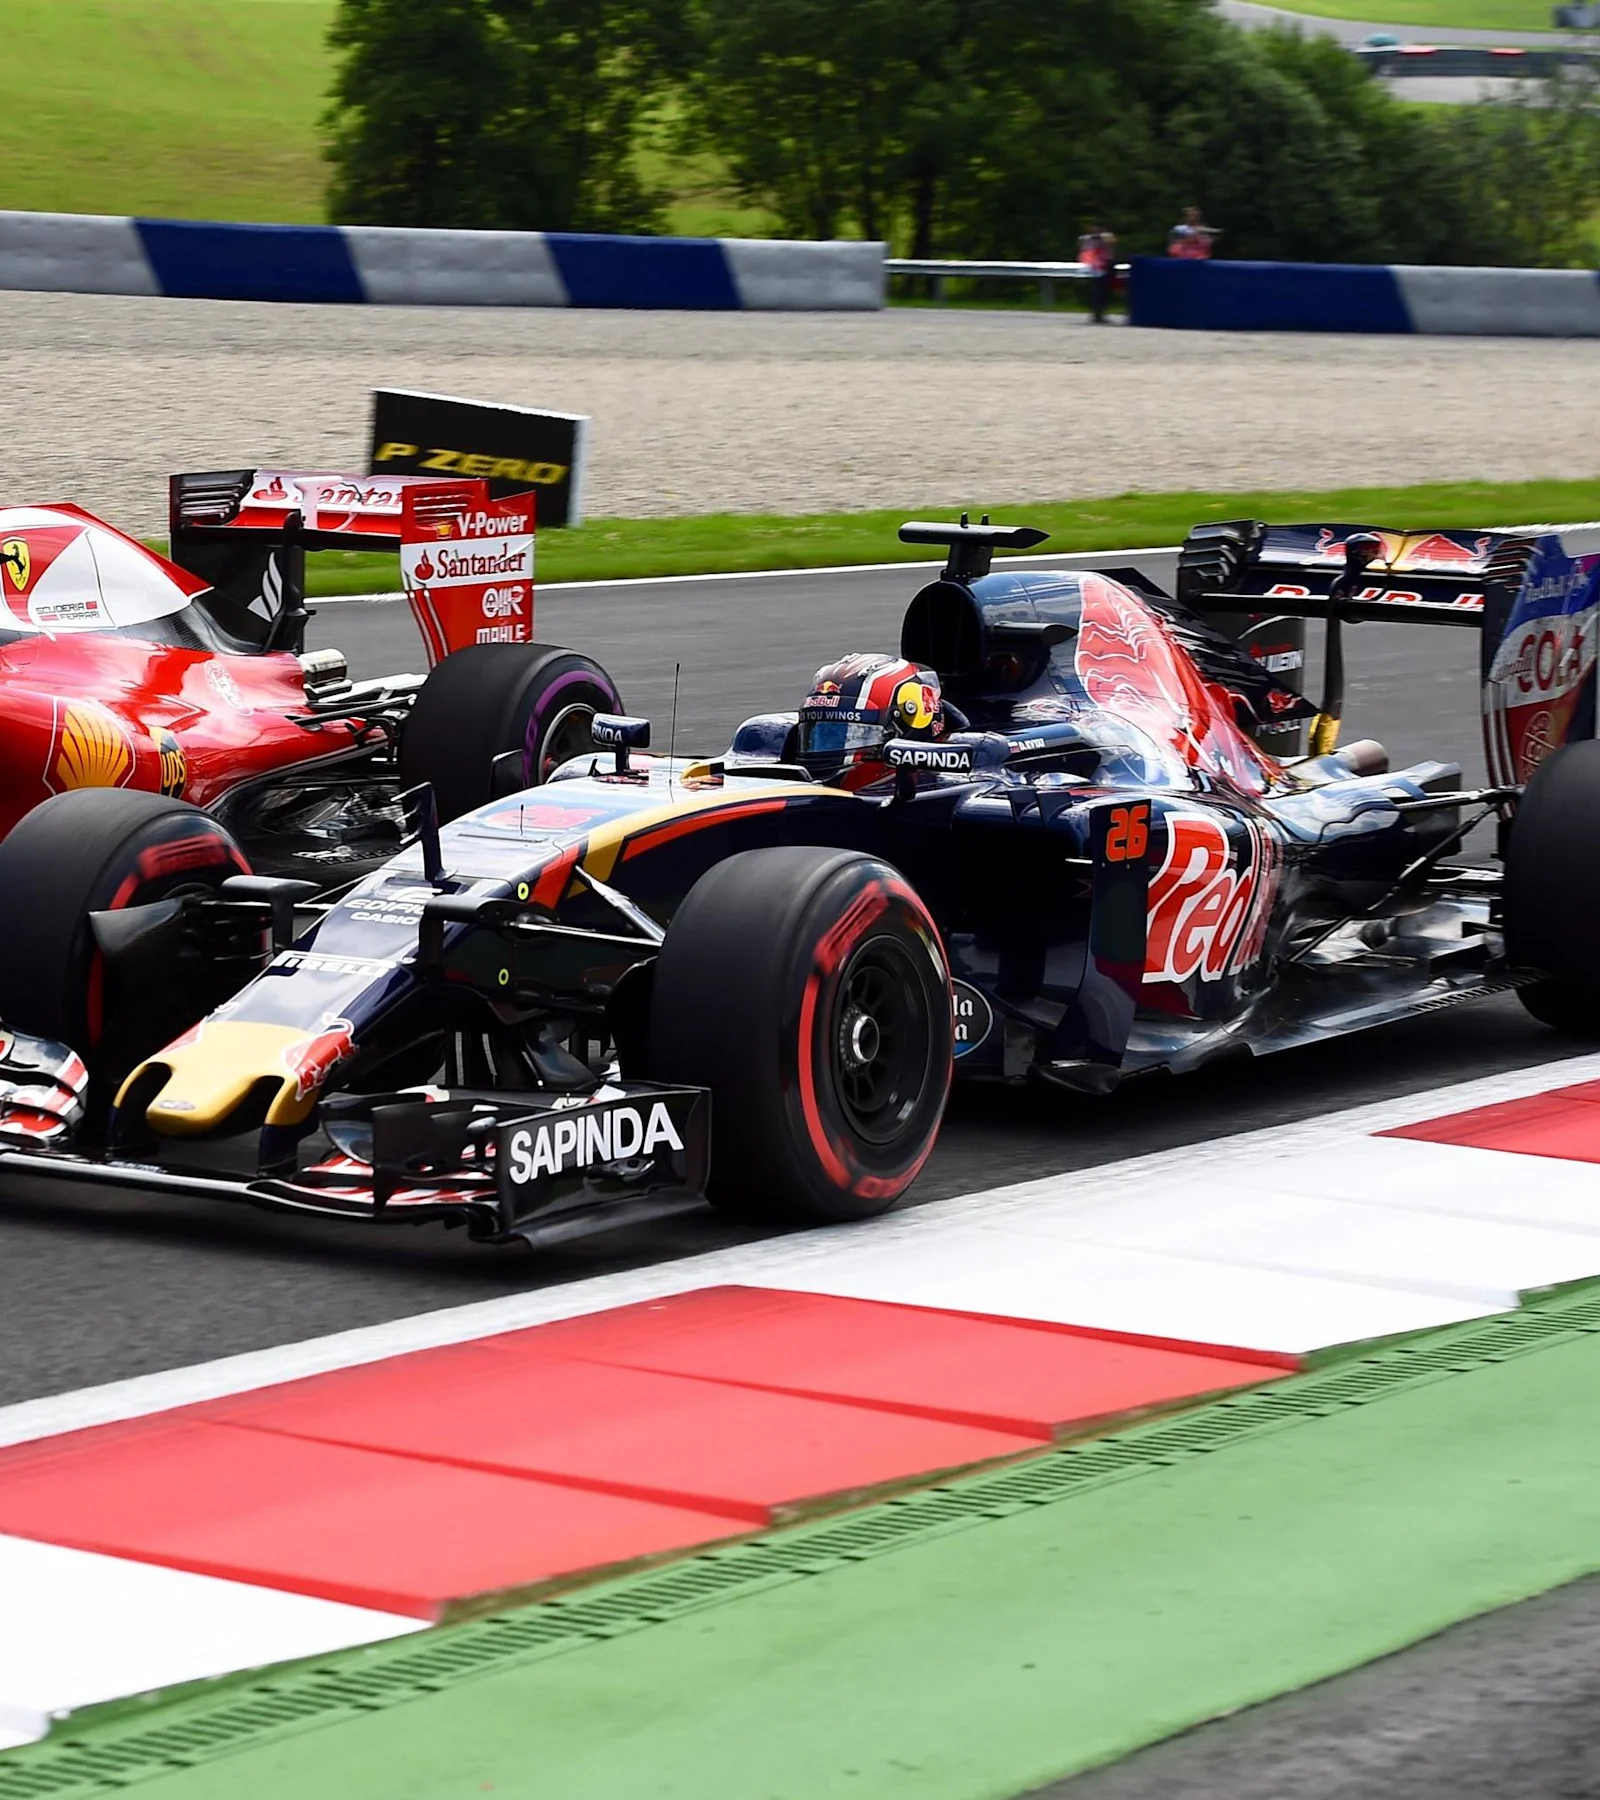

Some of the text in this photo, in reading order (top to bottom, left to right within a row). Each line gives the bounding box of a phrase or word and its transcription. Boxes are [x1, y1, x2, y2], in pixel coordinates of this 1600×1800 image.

[374, 442, 568, 485] P ZERO
[456, 511, 528, 537] V-Power
[437, 542, 526, 579] Santander
[35, 602, 85, 615] SCUDERIA
[59, 611, 100, 621] FERRARI
[476, 624, 526, 644] MAHLE
[807, 711, 823, 720] YOU
[826, 711, 861, 721] WINGS
[889, 749, 971, 769] SAPINDA
[1106, 805, 1149, 862] 26
[351, 912, 419, 926] CASIO
[509, 1102, 684, 1185] SAPINDA
